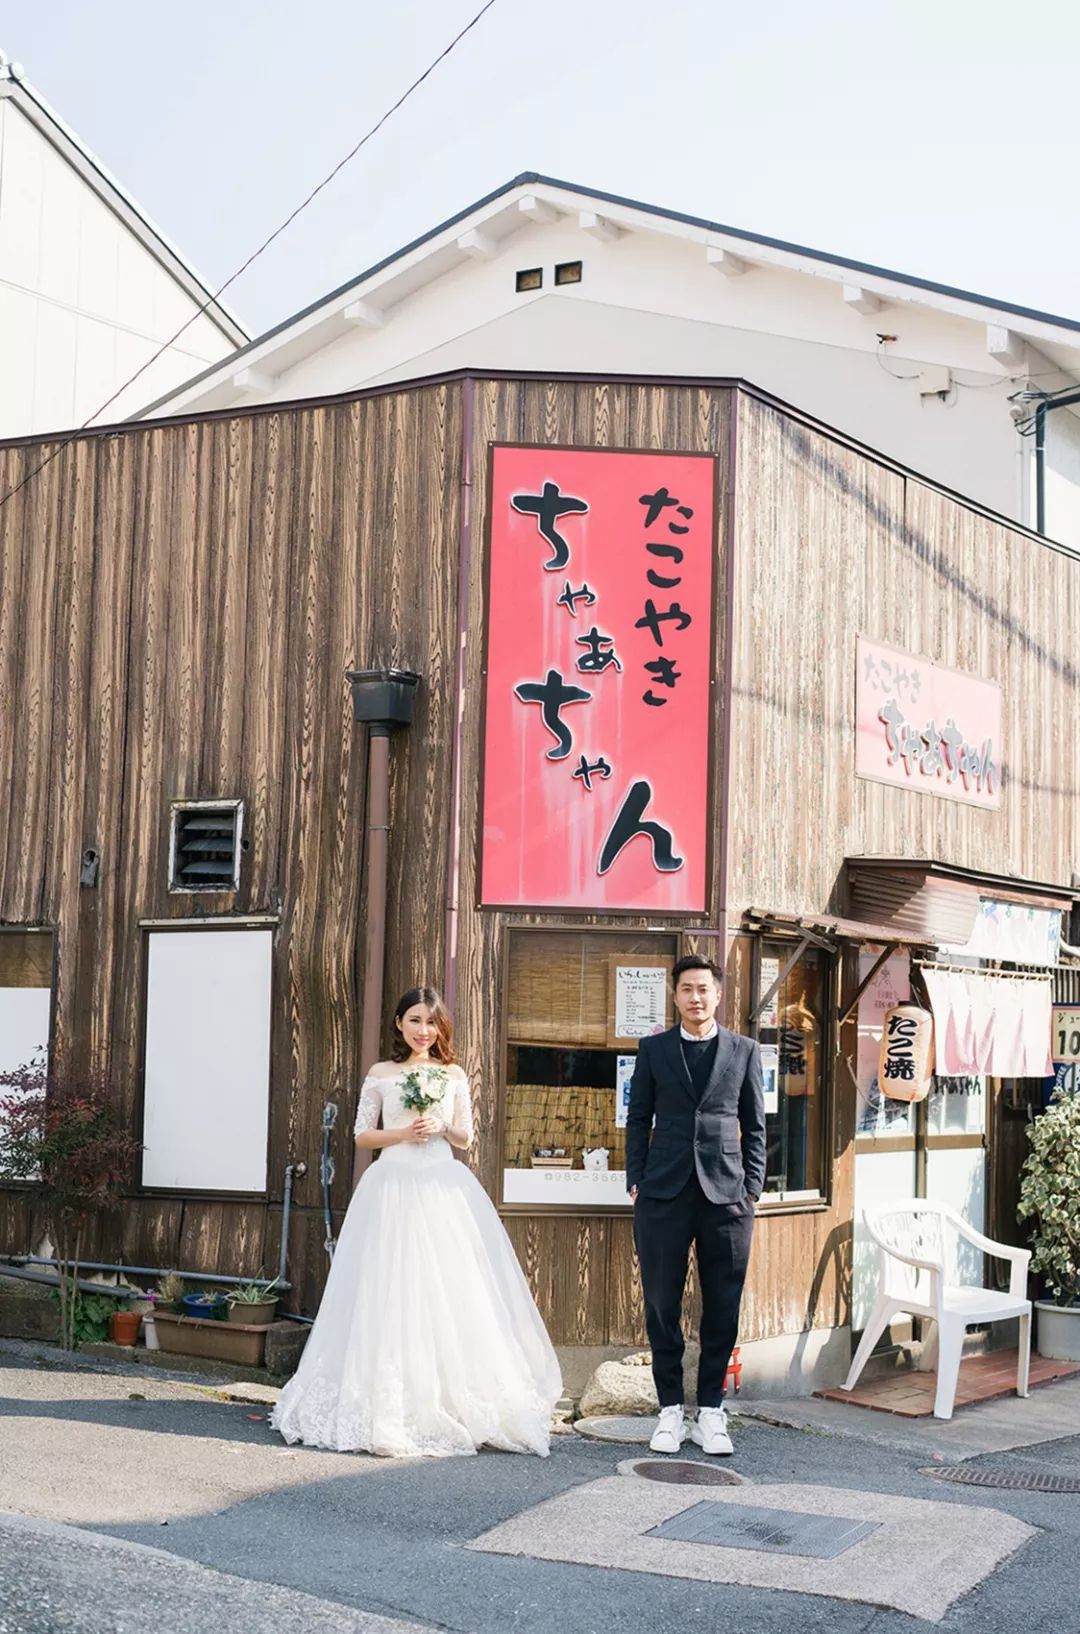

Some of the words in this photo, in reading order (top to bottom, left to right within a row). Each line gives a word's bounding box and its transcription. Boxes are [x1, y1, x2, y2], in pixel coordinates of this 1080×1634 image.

[635, 487, 694, 707] たこやき
[863, 652, 922, 703] たこやき
[884, 1015, 918, 1081] たこ焼
